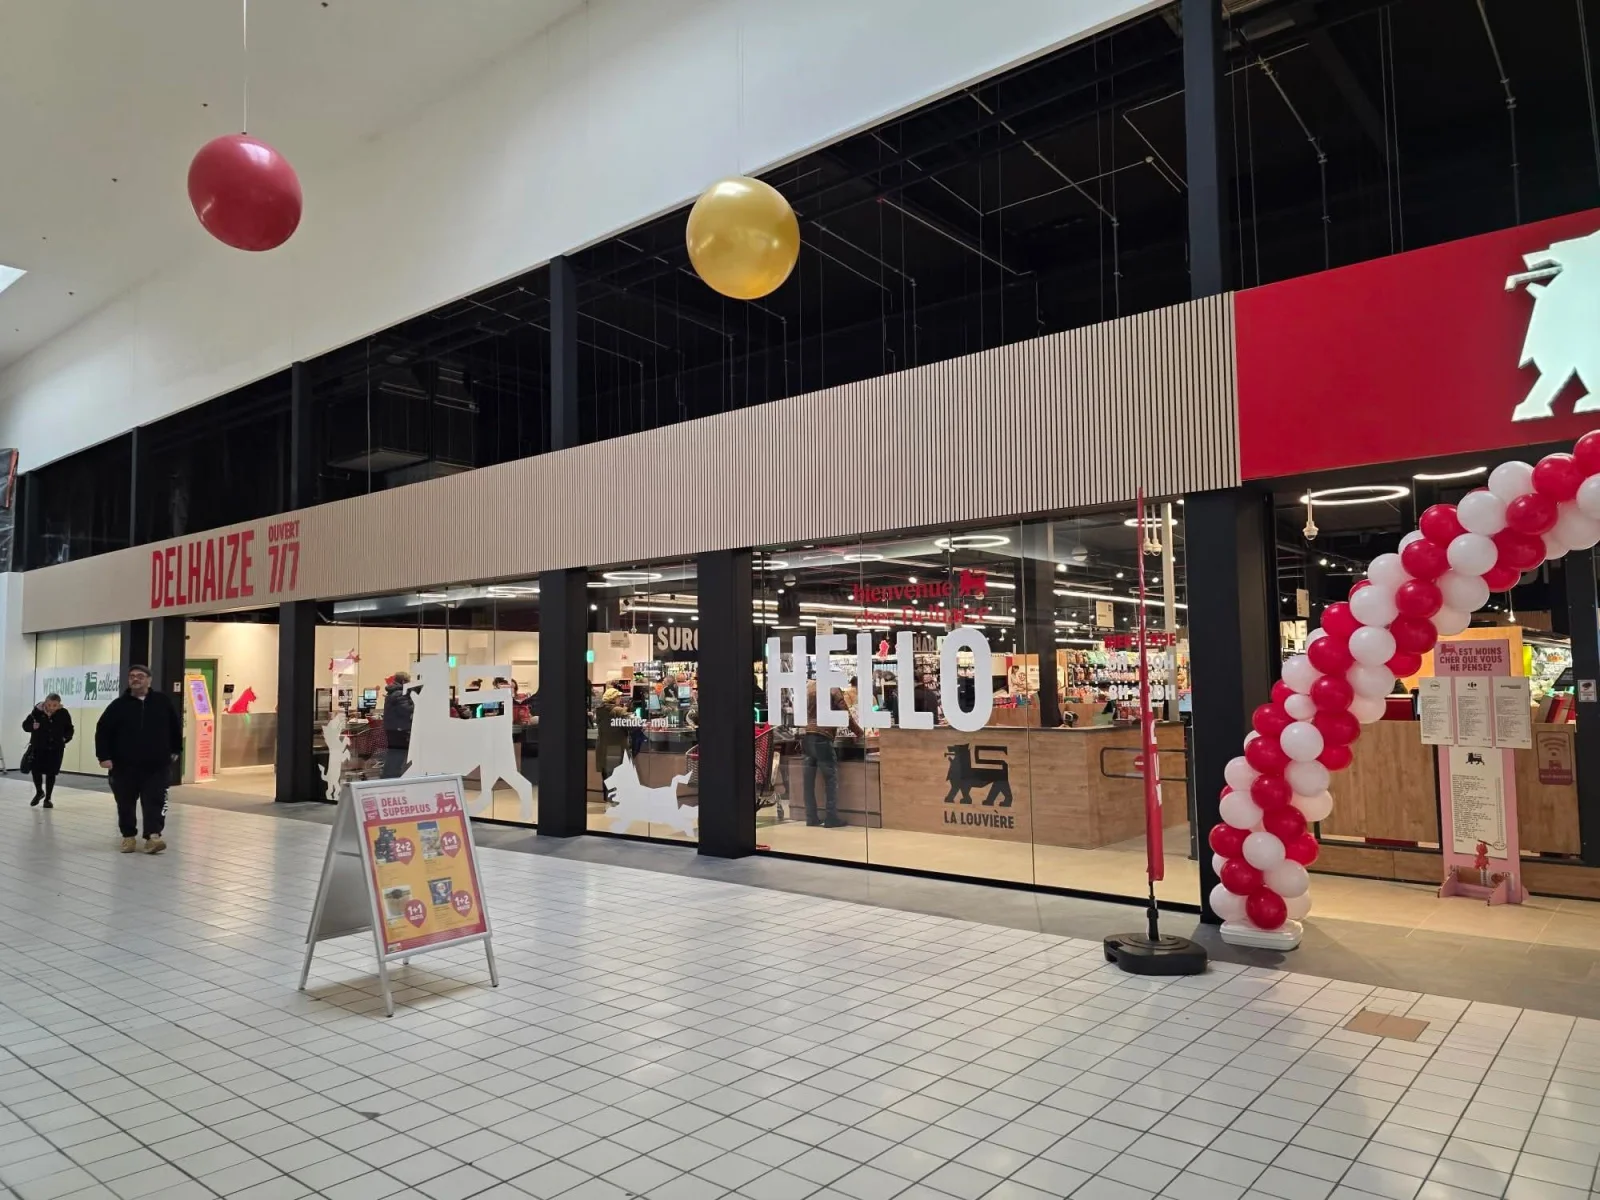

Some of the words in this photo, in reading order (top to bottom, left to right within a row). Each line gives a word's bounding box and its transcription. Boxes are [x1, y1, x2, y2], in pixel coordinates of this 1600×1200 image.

[268, 520, 300, 542] OUVERT
[150, 529, 255, 609] DELHAIZE
[268, 541, 300, 594] 7/7
[852, 580, 954, 603] bienvenue
[900, 603, 989, 626] Delhaize
[1439, 655, 1460, 664] CHER
[1462, 655, 1478, 664] QUE
[1480, 655, 1502, 663] VOUS
[1458, 647, 1472, 656] EST
[1476, 646, 1502, 656] MOINS
[1450, 663, 1459, 672] NE
[1462, 663, 1492, 671] PENSEZ
[43, 677, 75, 696] WELCOME
[767, 627, 993, 732] HELLO
[381, 796, 408, 808] DEALS
[383, 803, 431, 818] SUPERPLUS
[944, 810, 957, 824] LA
[960, 809, 1014, 829] LOUVIÈRE
[395, 842, 412, 852] 2+2
[442, 836, 458, 846] 1+1
[408, 904, 423, 915] 1+1
